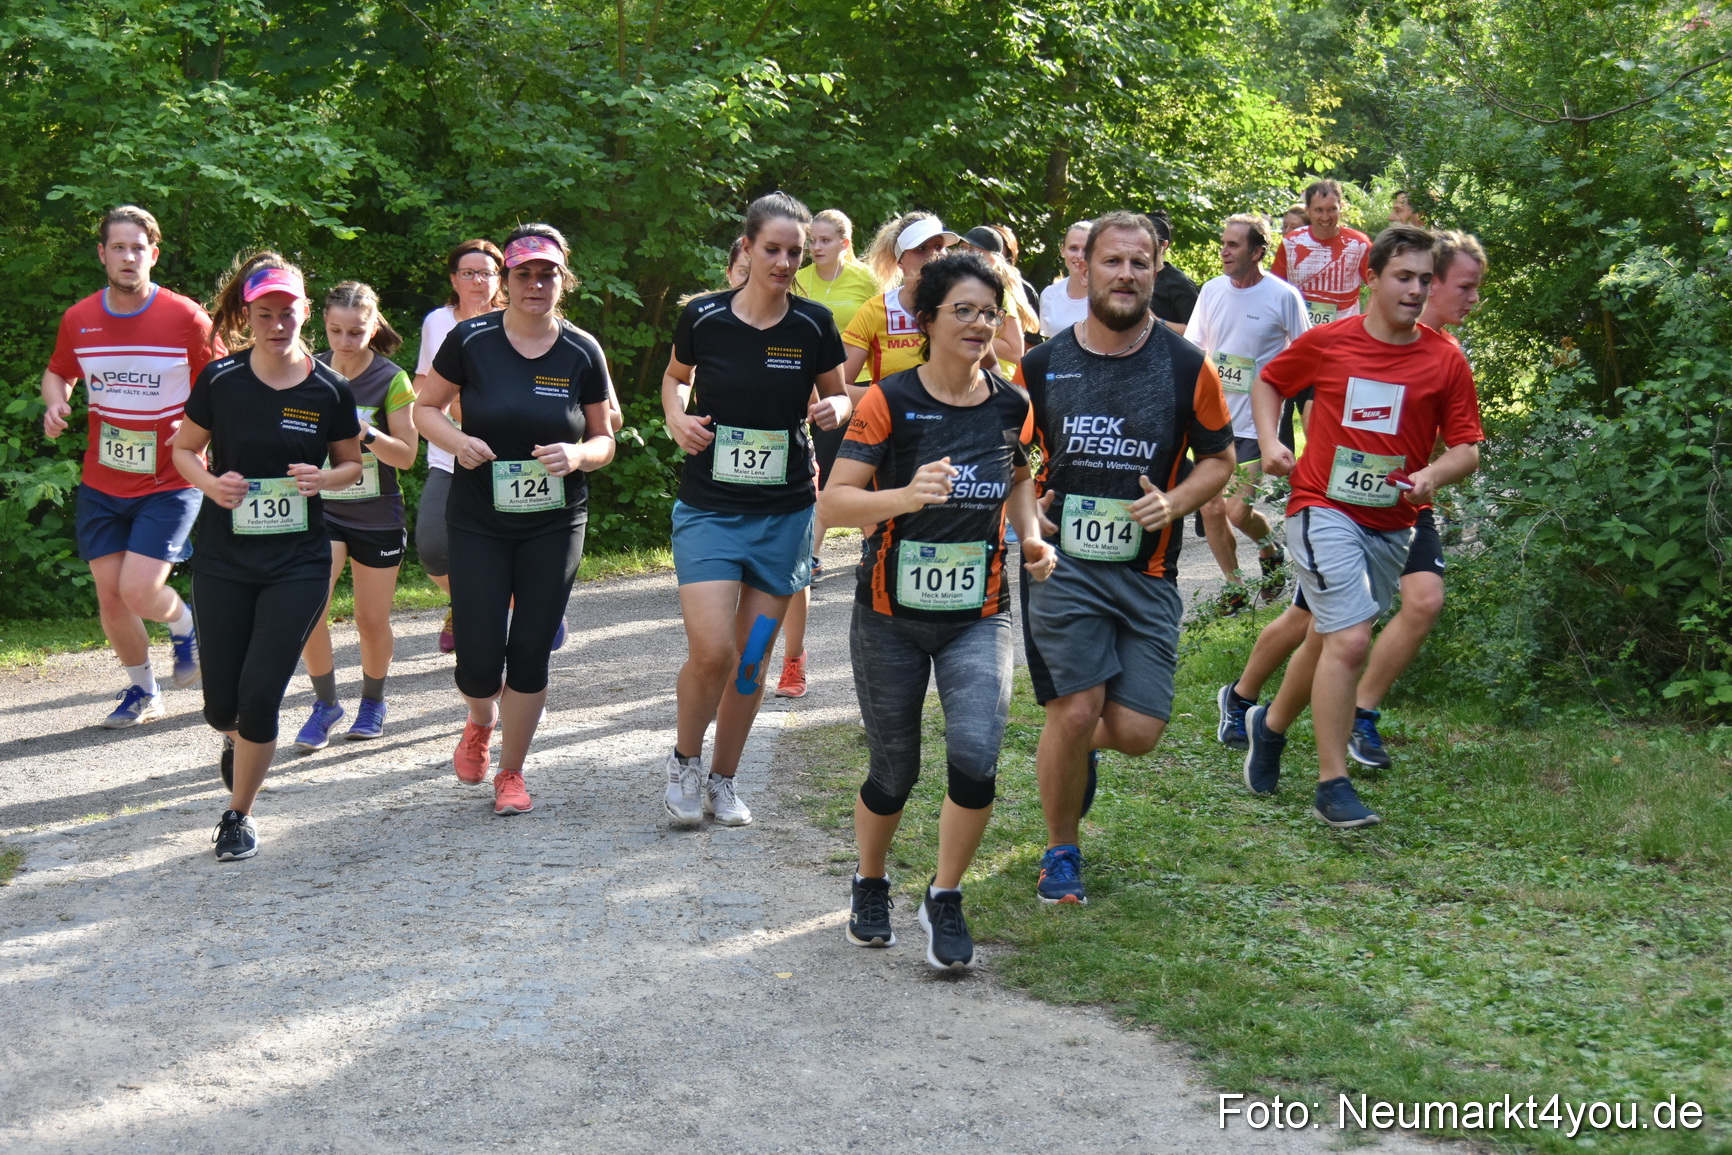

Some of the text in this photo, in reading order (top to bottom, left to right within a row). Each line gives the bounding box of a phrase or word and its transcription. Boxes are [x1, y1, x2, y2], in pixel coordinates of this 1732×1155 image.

[1217, 365, 1242, 382] 644
[1361, 410, 1381, 418] DEHN
[1062, 416, 1125, 436] HECK
[106, 440, 146, 462] 1811
[1066, 436, 1157, 460] DESIGN
[730, 448, 772, 470] 137
[1106, 461, 1149, 473] Werbung!
[948, 464, 979, 481] CK
[1344, 470, 1387, 493] 467
[510, 477, 550, 499] 124
[249, 498, 291, 518] 130
[1072, 518, 1132, 544] 1014
[1100, 543, 1119, 551] Mario
[910, 566, 975, 592] 1015
